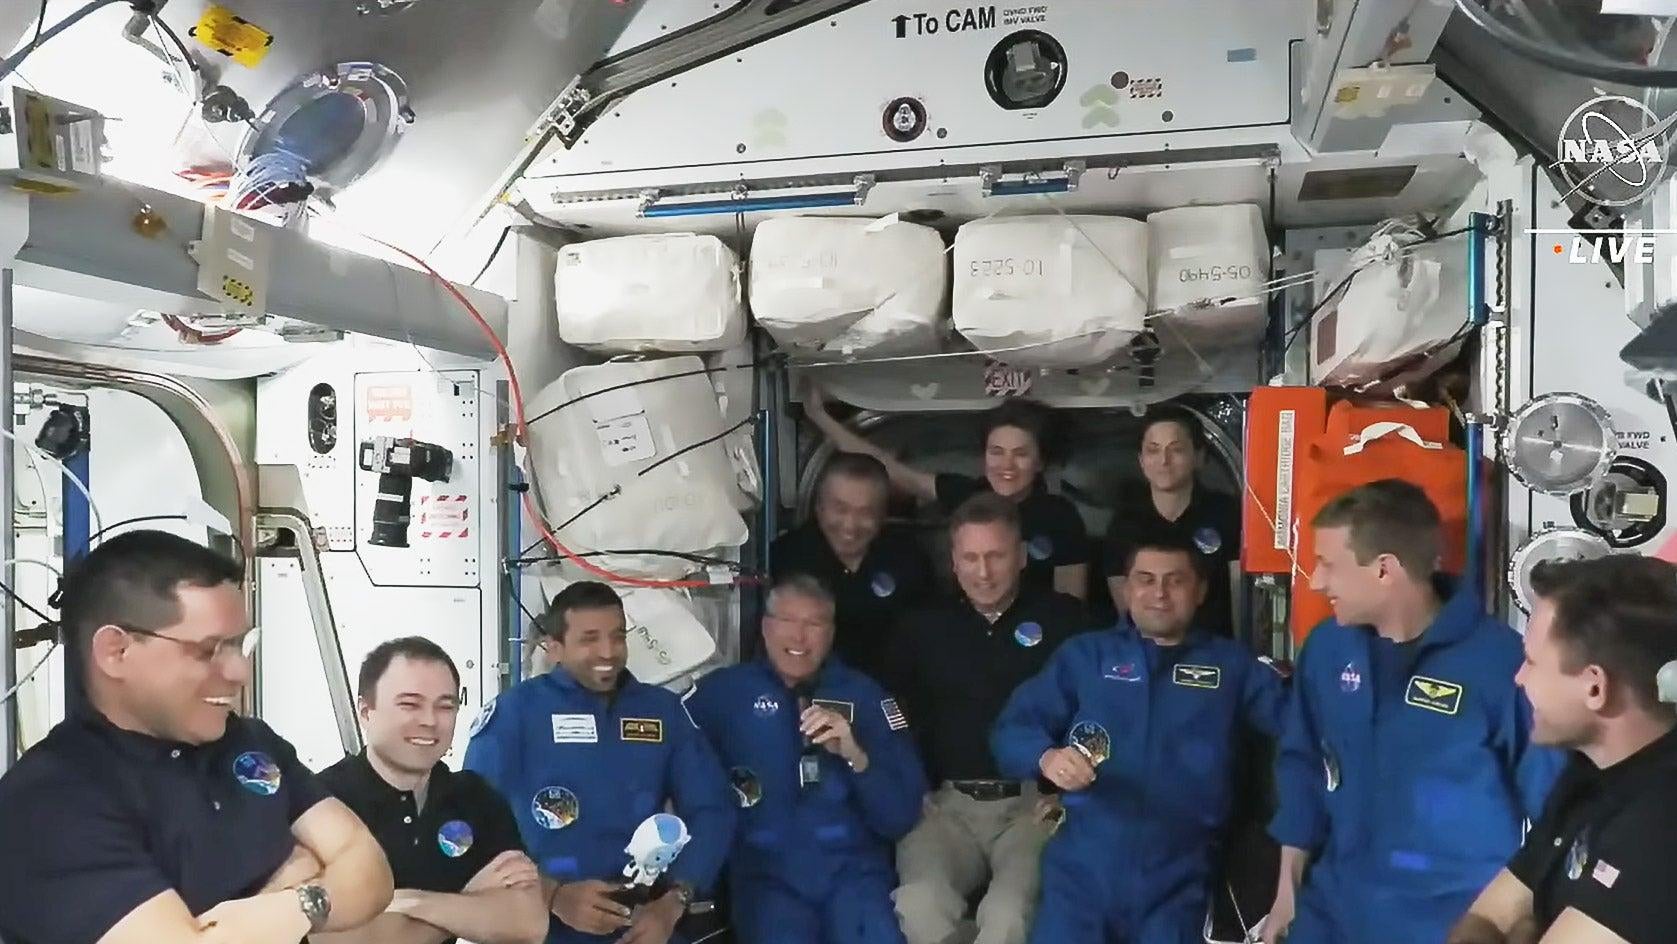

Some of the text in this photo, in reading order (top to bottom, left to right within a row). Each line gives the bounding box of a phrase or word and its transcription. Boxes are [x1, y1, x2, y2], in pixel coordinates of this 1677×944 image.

[913, 6, 996, 35] To CAM
[1020, 14, 1047, 24] VALVE
